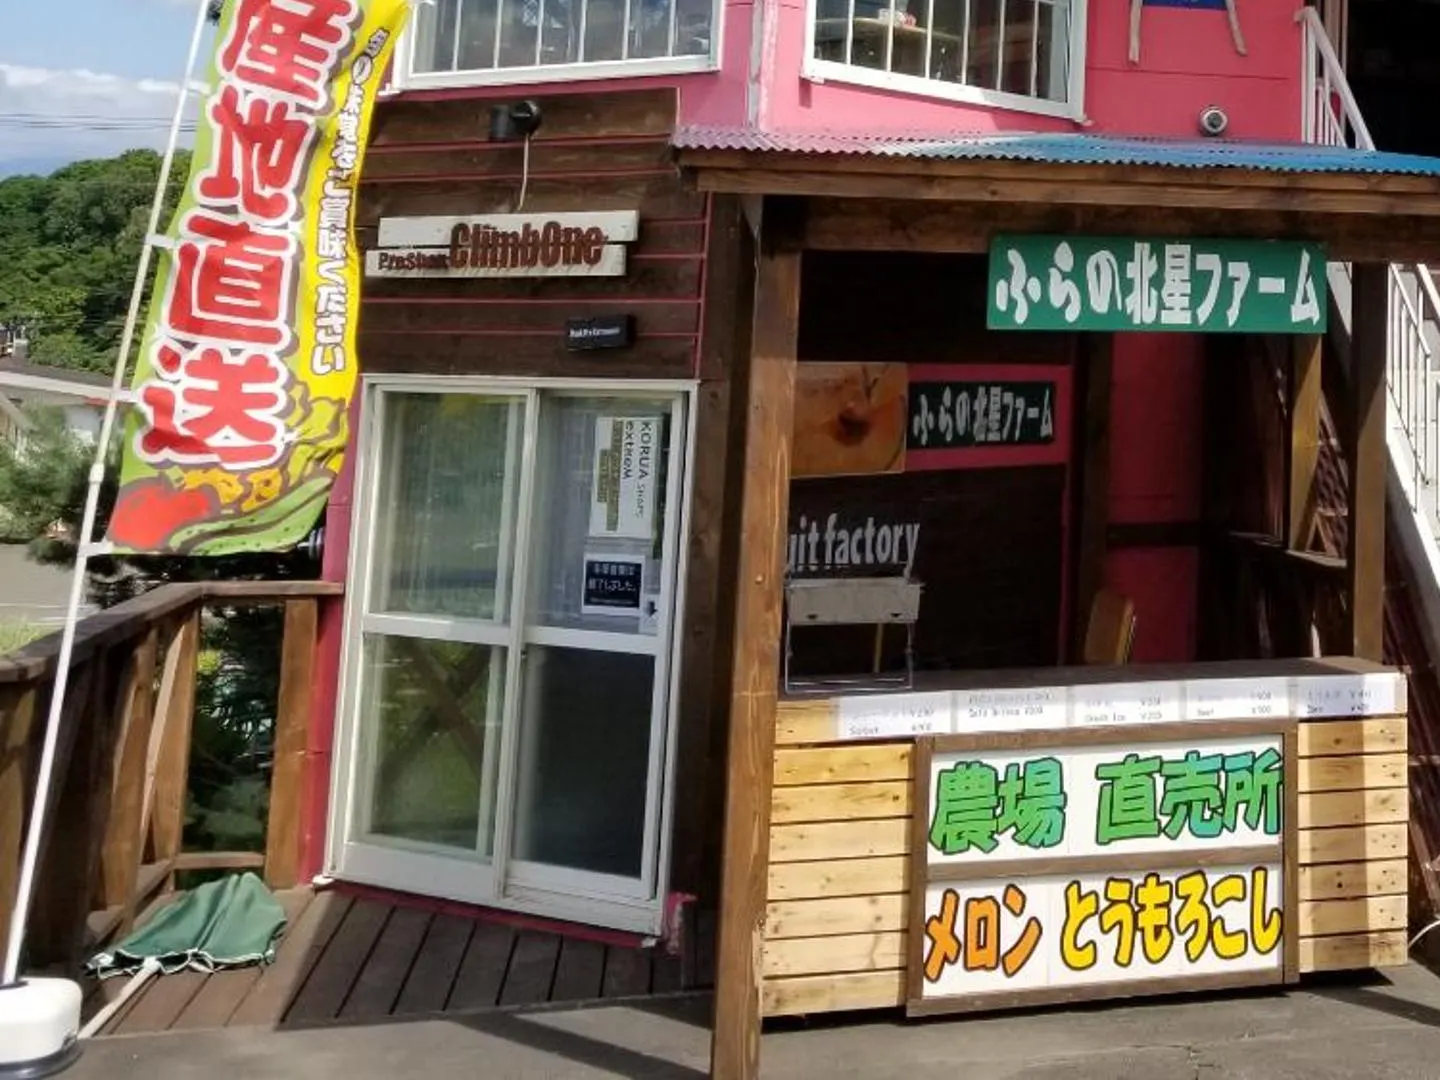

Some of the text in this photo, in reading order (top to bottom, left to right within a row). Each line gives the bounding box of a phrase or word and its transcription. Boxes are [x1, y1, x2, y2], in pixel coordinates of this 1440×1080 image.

[450, 220, 608, 269] ClimbOne
[995, 240, 1321, 327] ふらの北星ファーム
[912, 385, 1053, 447] ふらの北星ファーム
[824, 512, 921, 583] factory
[928, 748, 1284, 856] 農場 直売所
[923, 866, 1284, 984] メロン とうもろこし
